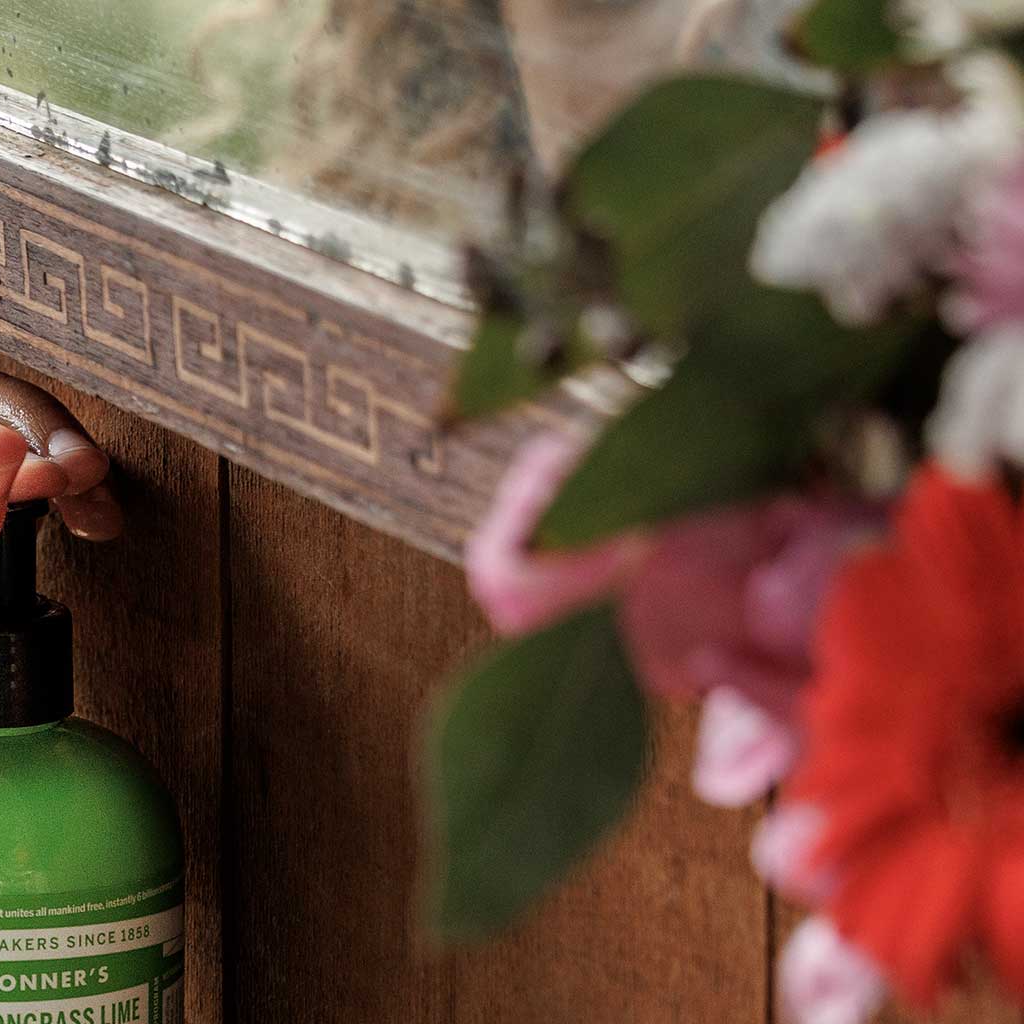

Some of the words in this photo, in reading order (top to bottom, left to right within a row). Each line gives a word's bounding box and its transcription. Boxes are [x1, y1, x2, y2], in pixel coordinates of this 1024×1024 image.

[5, 908, 34, 918] unites
[36, 906, 46, 917] all
[48, 903, 86, 916] mankind
[66, 931, 116, 948] SINCE
[120, 925, 150, 942] 1858
